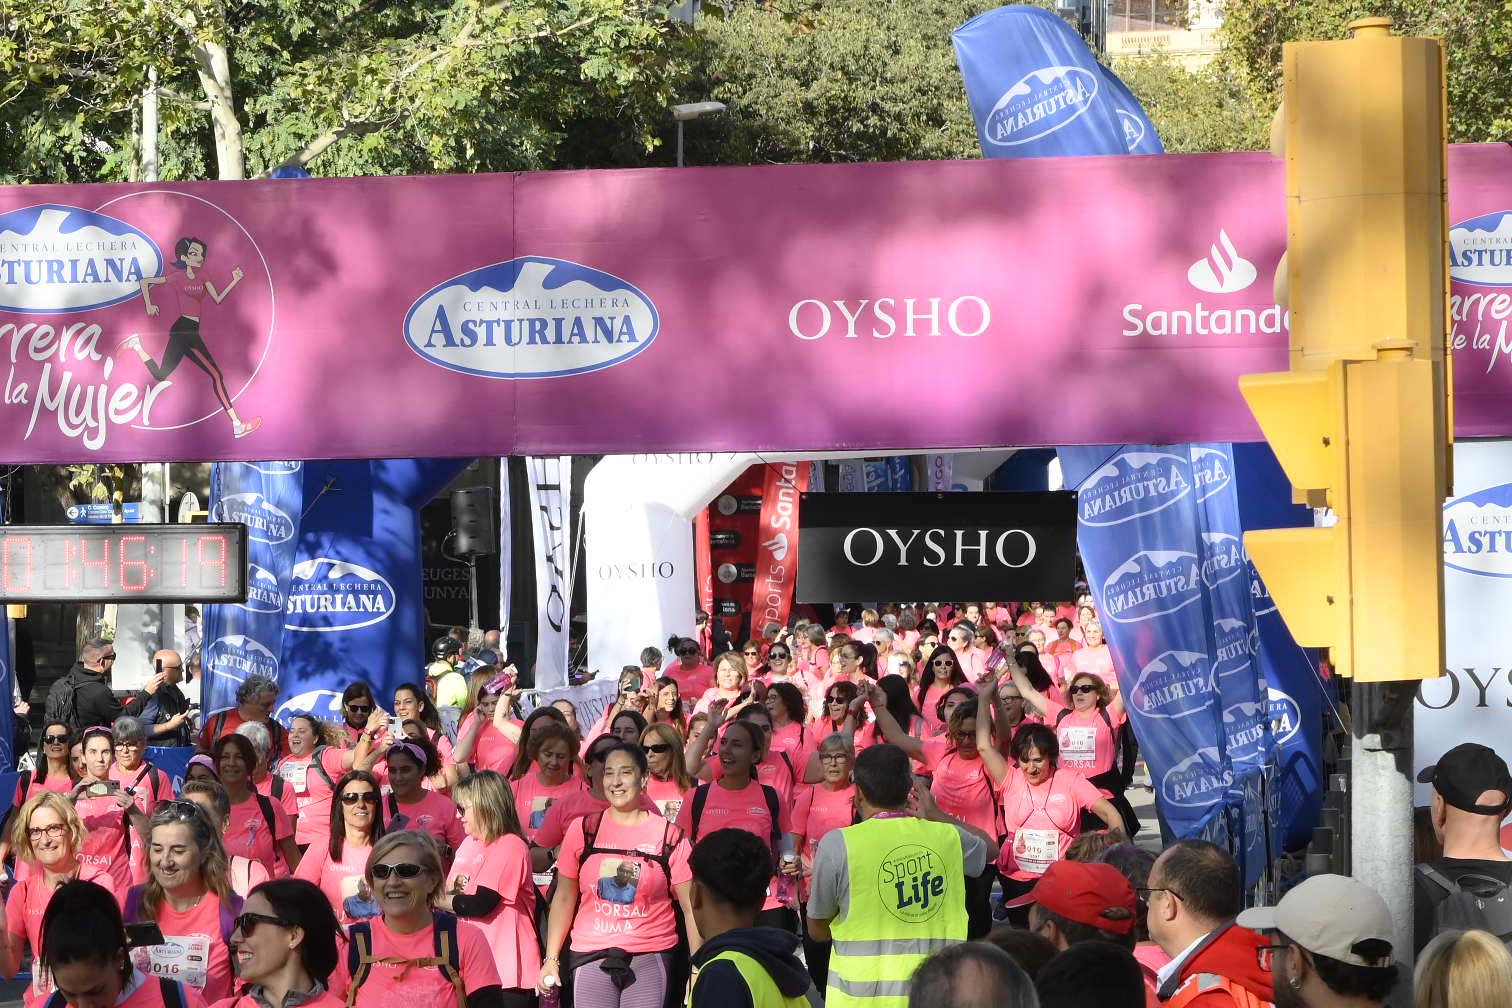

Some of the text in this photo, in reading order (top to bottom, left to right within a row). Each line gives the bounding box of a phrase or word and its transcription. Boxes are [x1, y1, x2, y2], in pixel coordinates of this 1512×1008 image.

[66, 240, 138, 252] LECHERA
[462, 297, 631, 312] CENTRAL LECHERA
[788, 295, 993, 340] OYSHO
[424, 304, 639, 349] ASTURIANA
[1472, 321, 1491, 350] la
[4, 363, 28, 404] la
[24, 357, 174, 450] Mujer
[843, 527, 1037, 568] OYSHO
[333, 582, 382, 591] LECHERA
[882, 850, 933, 884] Sport
[894, 870, 944, 910] Life
[594, 901, 647, 918] DORSAL
[593, 917, 633, 934] SUMA
[153, 962, 180, 974] 016
